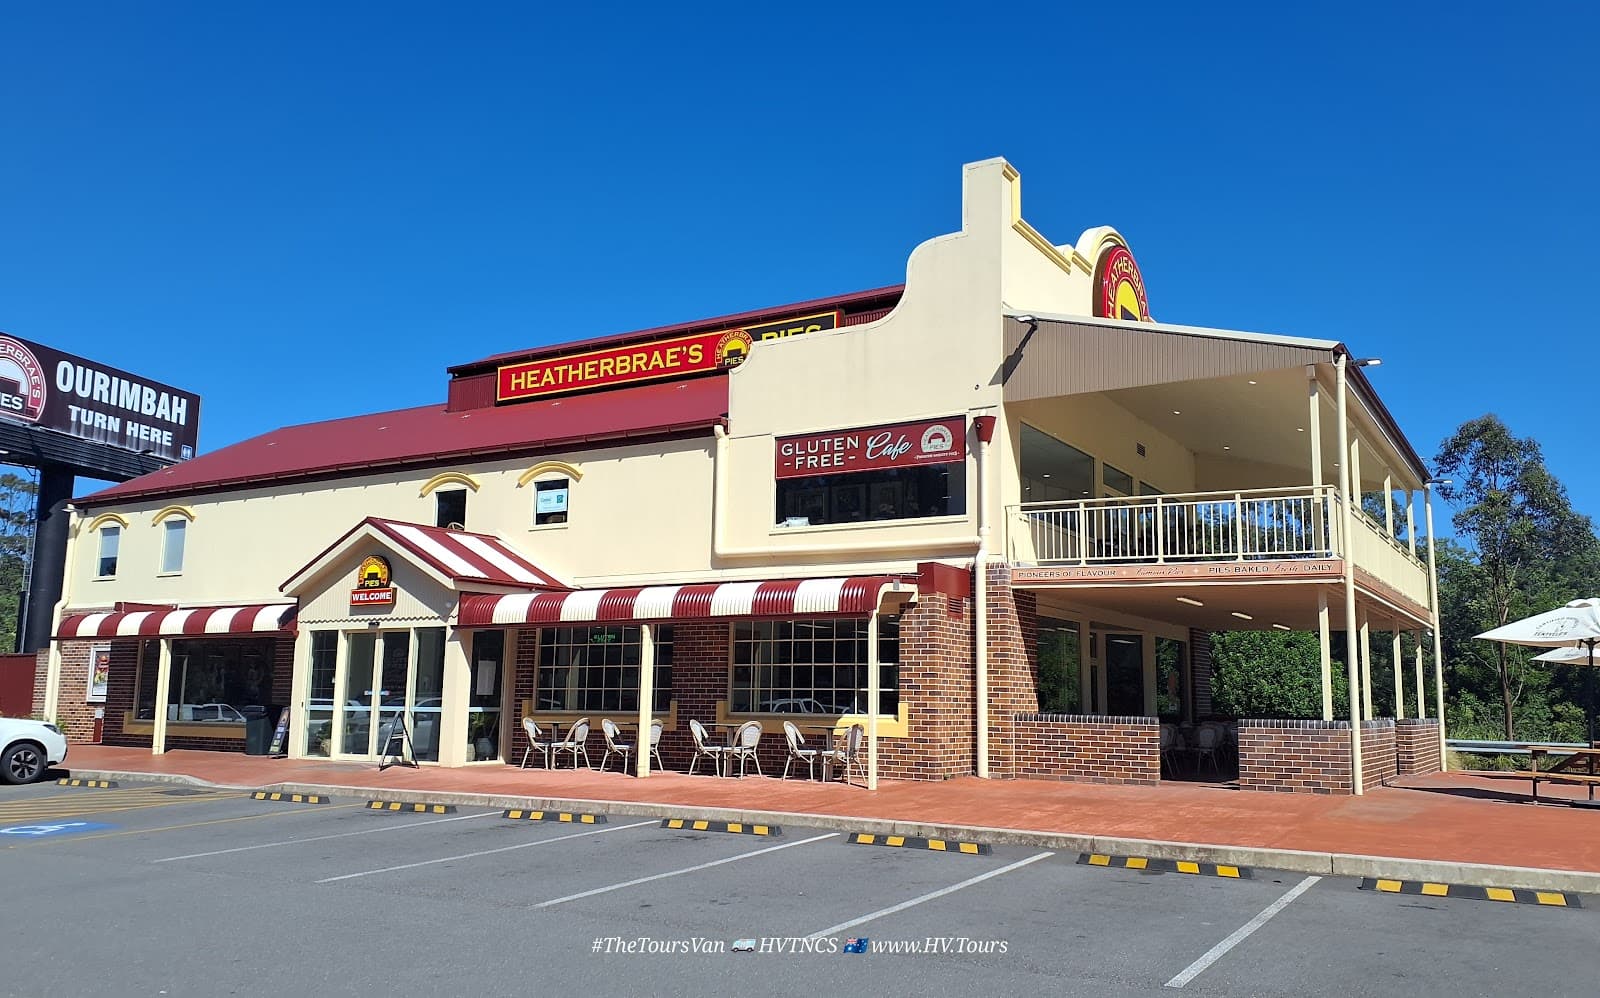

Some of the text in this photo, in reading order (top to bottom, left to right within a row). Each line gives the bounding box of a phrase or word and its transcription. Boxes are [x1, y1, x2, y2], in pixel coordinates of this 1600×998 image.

[510, 344, 704, 391] HEATHERBRAE'S
[724, 356, 744, 366] PIES
[0, 392, 23, 410] ES
[56, 360, 187, 426] OURIMBAH
[67, 405, 173, 446] TURN HERE
[781, 435, 860, 456] GLUTEN
[866, 431, 913, 461] Cafe
[1303, 563, 1333, 572] DAILY
[352, 592, 391, 601] WELCOME
